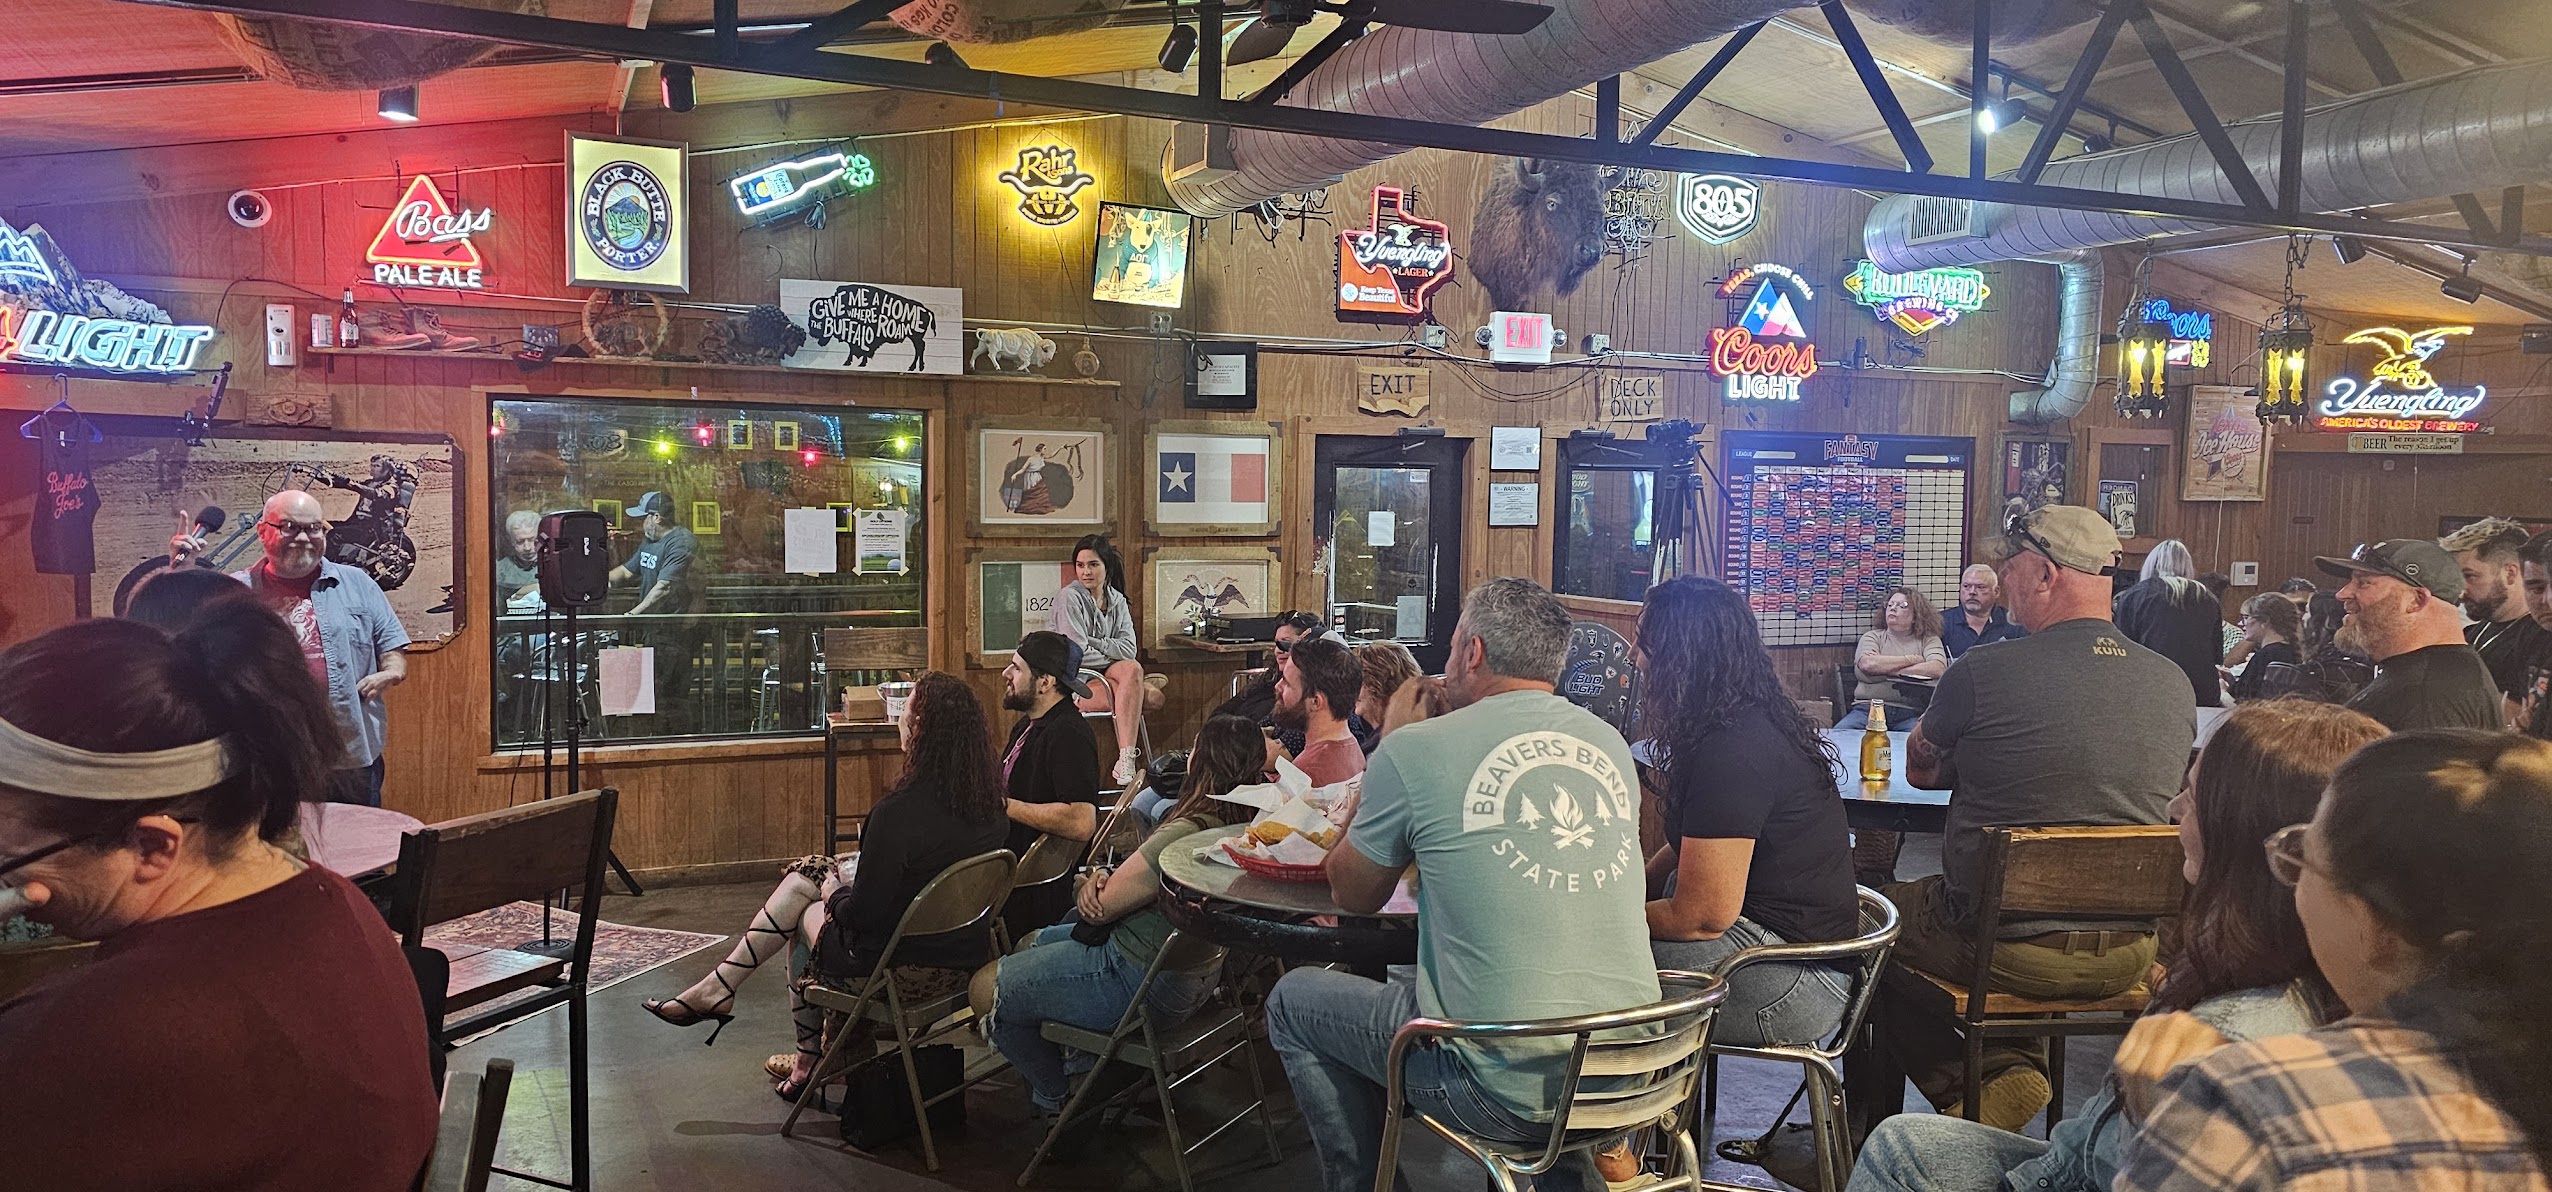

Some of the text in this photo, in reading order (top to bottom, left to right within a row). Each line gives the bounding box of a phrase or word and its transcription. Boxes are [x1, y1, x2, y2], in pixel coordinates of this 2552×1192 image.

[1020, 148, 1073, 185] Rahr
[587, 167, 666, 222] BLACK BUTTE
[1603, 188, 1672, 220] BITA
[1692, 183, 1752, 218] 805
[396, 200, 491, 238] Bass
[1356, 233, 1450, 268] Yuengling
[374, 263, 483, 288] PALE ALE
[1398, 268, 1428, 277] LAGER
[1753, 263, 1793, 278] CHOOSE
[1791, 274, 1814, 300] CHILL
[1871, 267, 1978, 303] BOULEVARD
[1359, 292, 1397, 303] Beautiful
[1360, 285, 1375, 294] Keep
[811, 288, 927, 333] GIVE ME A HOME
[847, 307, 877, 324] WHERE
[17, 309, 214, 371] LIGHT
[810, 314, 913, 352] THE BUFFALO ROAM
[1504, 316, 1545, 349] EXIT
[1713, 325, 1818, 379] Coors
[1371, 373, 1416, 395] EXIT
[1611, 378, 1656, 398] DECK
[1728, 374, 1803, 400] LIGHT
[1611, 400, 1655, 417] ONLY
[2321, 378, 2486, 419] Yuengling
[2320, 416, 2479, 432] AMERICA'S OLDEST BREWERY
[1823, 439, 1880, 461] FANTASY
[2191, 430, 2261, 460] Ice House
[2363, 438, 2387, 450] BEER
[2435, 436, 2449, 444] get
[47, 471, 89, 495] Buffalo
[54, 494, 84, 519] Joe's
[2092, 646, 2127, 657] KUIU
[1568, 682, 1605, 695] LIGHT
[1575, 672, 1604, 685] BUD
[1472, 739, 1627, 815] BEAVERS BEND
[1491, 831, 1632, 893] STATE PARK
